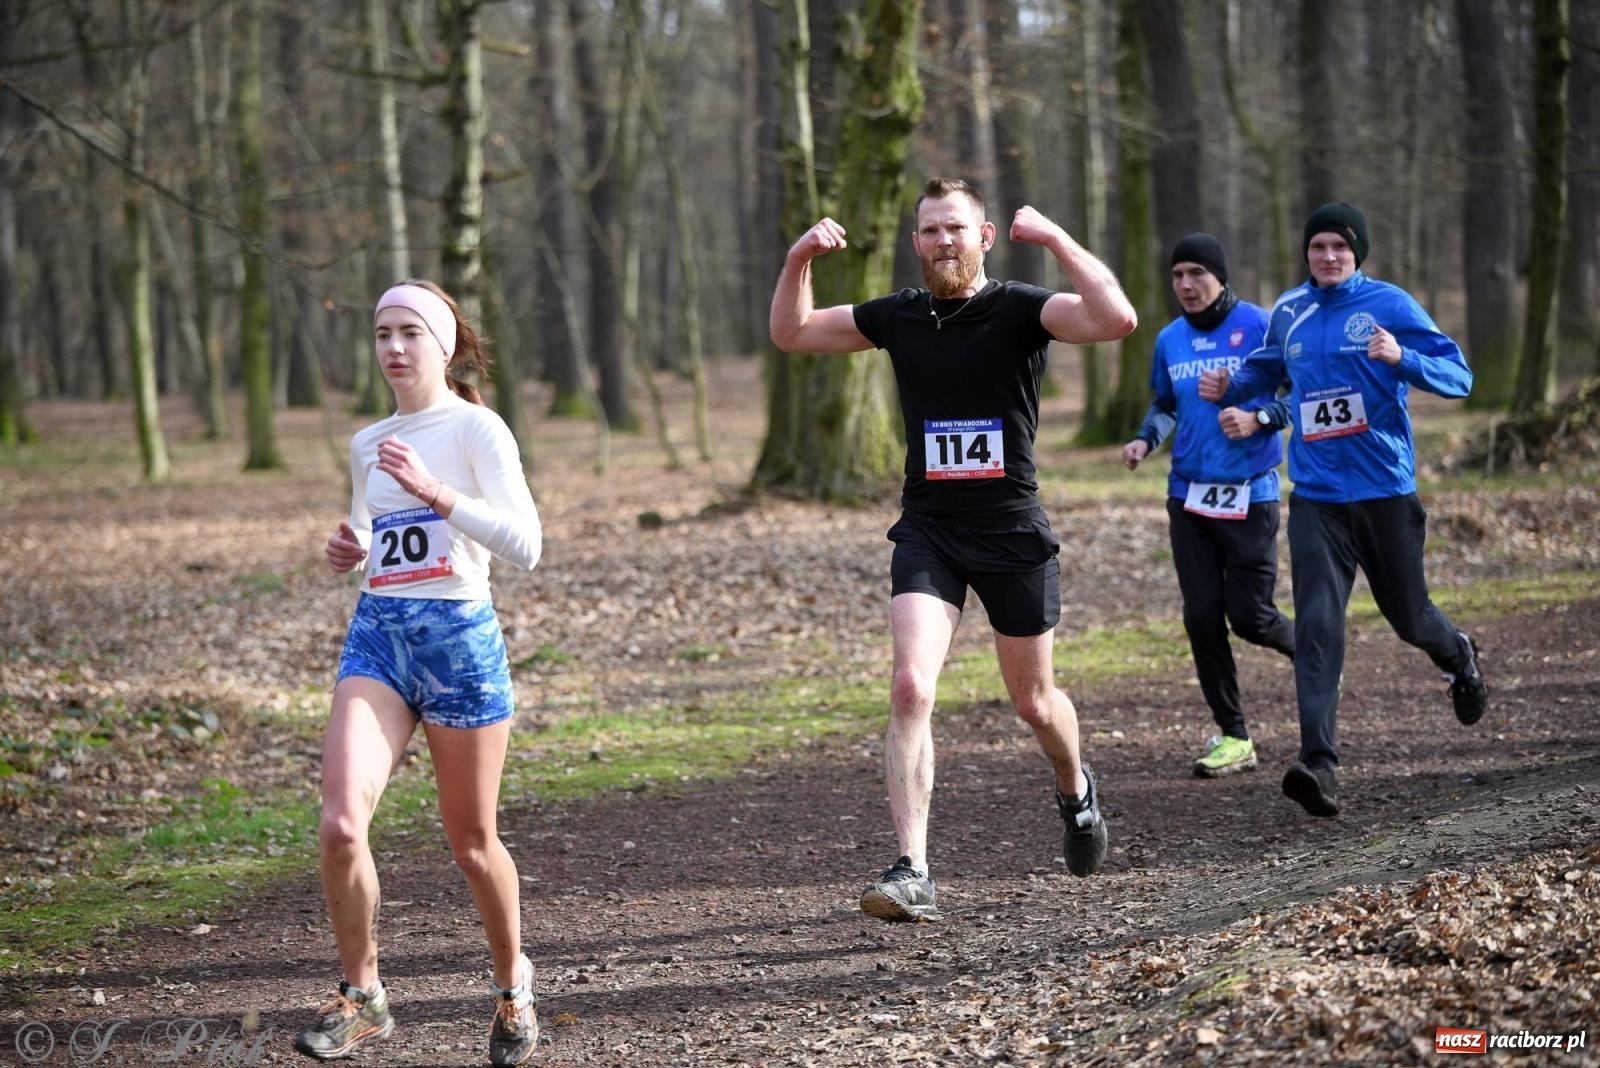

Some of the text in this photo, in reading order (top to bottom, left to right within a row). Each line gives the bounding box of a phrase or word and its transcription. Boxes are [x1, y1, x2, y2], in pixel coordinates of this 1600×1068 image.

[1314, 398, 1352, 427] 43
[935, 433, 991, 465] 114
[1201, 486, 1237, 509] 42
[392, 508, 434, 520] TWARDZIELA
[381, 525, 429, 568] 20
